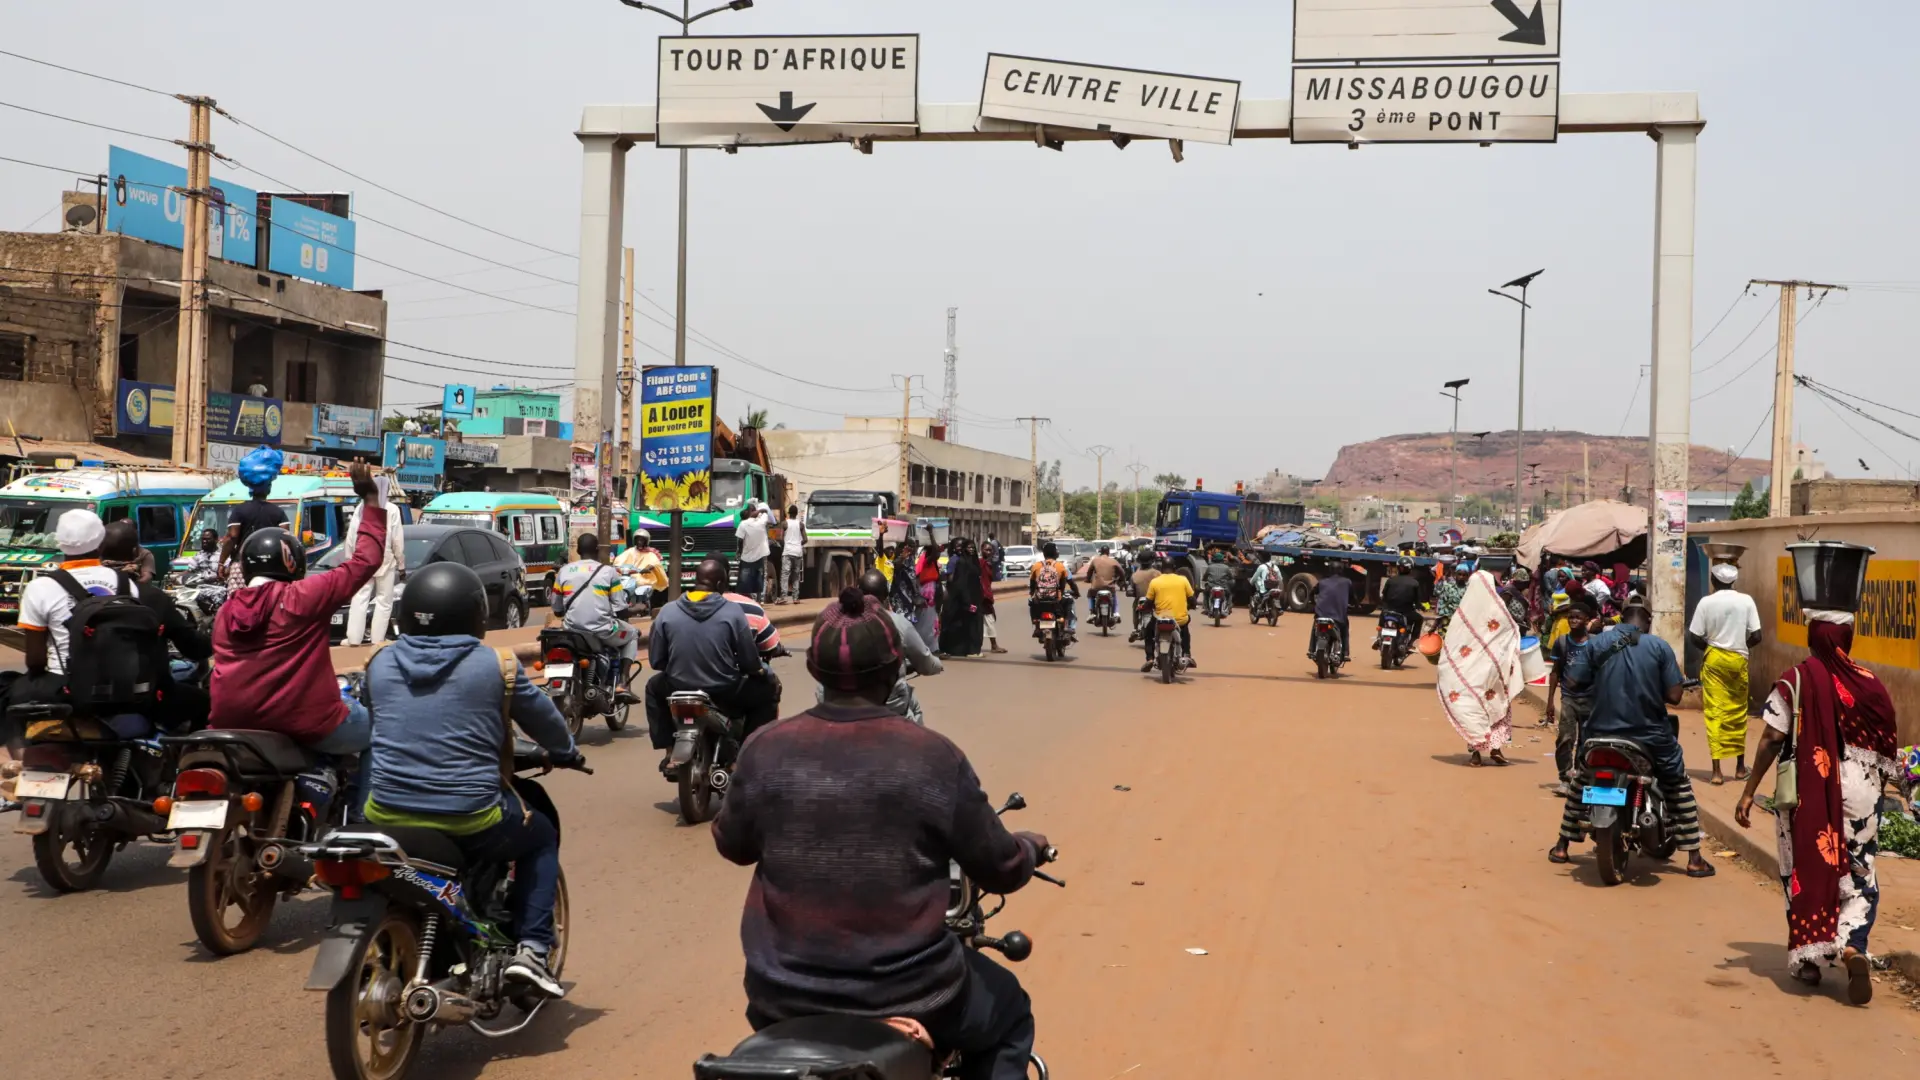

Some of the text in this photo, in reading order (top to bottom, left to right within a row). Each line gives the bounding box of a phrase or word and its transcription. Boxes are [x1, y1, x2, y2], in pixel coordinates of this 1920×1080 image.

[670, 47, 906, 71] TOUR D'AFRIQUE
[1003, 69, 1222, 115] CENTRE VILLE
[1306, 74, 1549, 101] MISSABOUGOU
[1348, 108, 1501, 131] 3 ème PONT
[129, 186, 159, 206] wave
[647, 373, 706, 385] Filany Com &
[656, 384, 696, 396] ABF Com
[648, 404, 704, 423] A Louer
[648, 420, 703, 434] pour votre PUB
[407, 443, 435, 460] wave
[658, 448, 667, 456] 71
[670, 446, 679, 455] 31
[682, 445, 692, 454] 15
[670, 457, 679, 465] 19
[694, 455, 704, 463] 44
